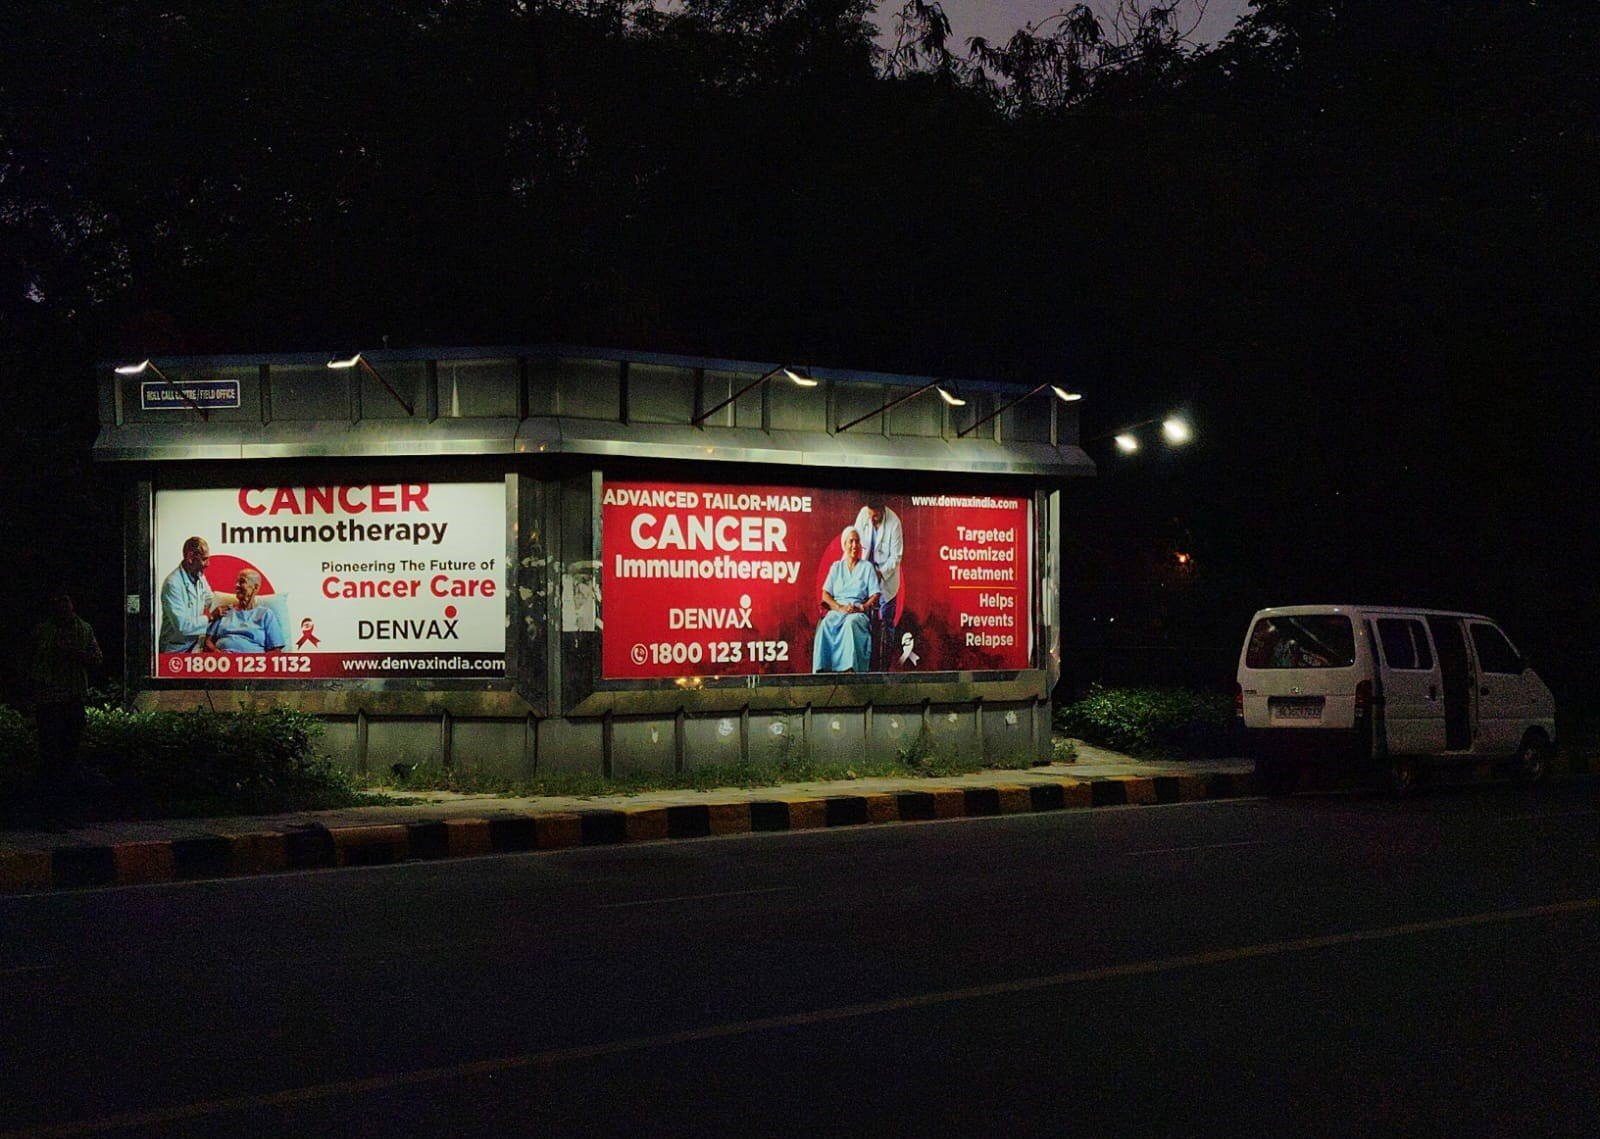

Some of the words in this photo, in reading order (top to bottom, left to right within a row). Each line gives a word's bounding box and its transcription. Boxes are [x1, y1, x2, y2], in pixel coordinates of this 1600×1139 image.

[216, 389, 235, 399] OFFICE
[238, 483, 429, 515] CANCER
[604, 489, 699, 508] ADVANCED
[703, 494, 812, 512] TAILOR-MADE
[912, 496, 1018, 509] www.denvaxindia.com
[221, 520, 448, 544] Immunotherapy
[631, 513, 787, 552] CANCER
[957, 527, 1013, 543] Targeted
[940, 546, 1013, 561] Customized
[321, 561, 395, 573] Pioneering
[400, 560, 425, 571] The
[430, 560, 476, 571] Future
[480, 559, 495, 570] of
[616, 555, 800, 584] Immunotherapy
[949, 566, 1013, 581] Treatment
[322, 577, 420, 598] Cancer
[431, 575, 496, 597] Care
[980, 594, 1013, 610] Helps
[670, 608, 752, 629] DENVAX
[960, 613, 1013, 627] Prevents
[358, 619, 459, 640] DENVAX
[966, 632, 1013, 648] Relapse
[650, 643, 702, 664] 1800
[709, 642, 742, 663] 123
[748, 641, 788, 662] 1132
[185, 656, 230, 673] 1800
[236, 656, 266, 672] 123
[272, 656, 311, 672] 1132
[342, 658, 505, 671] www.denvaxindia.com
